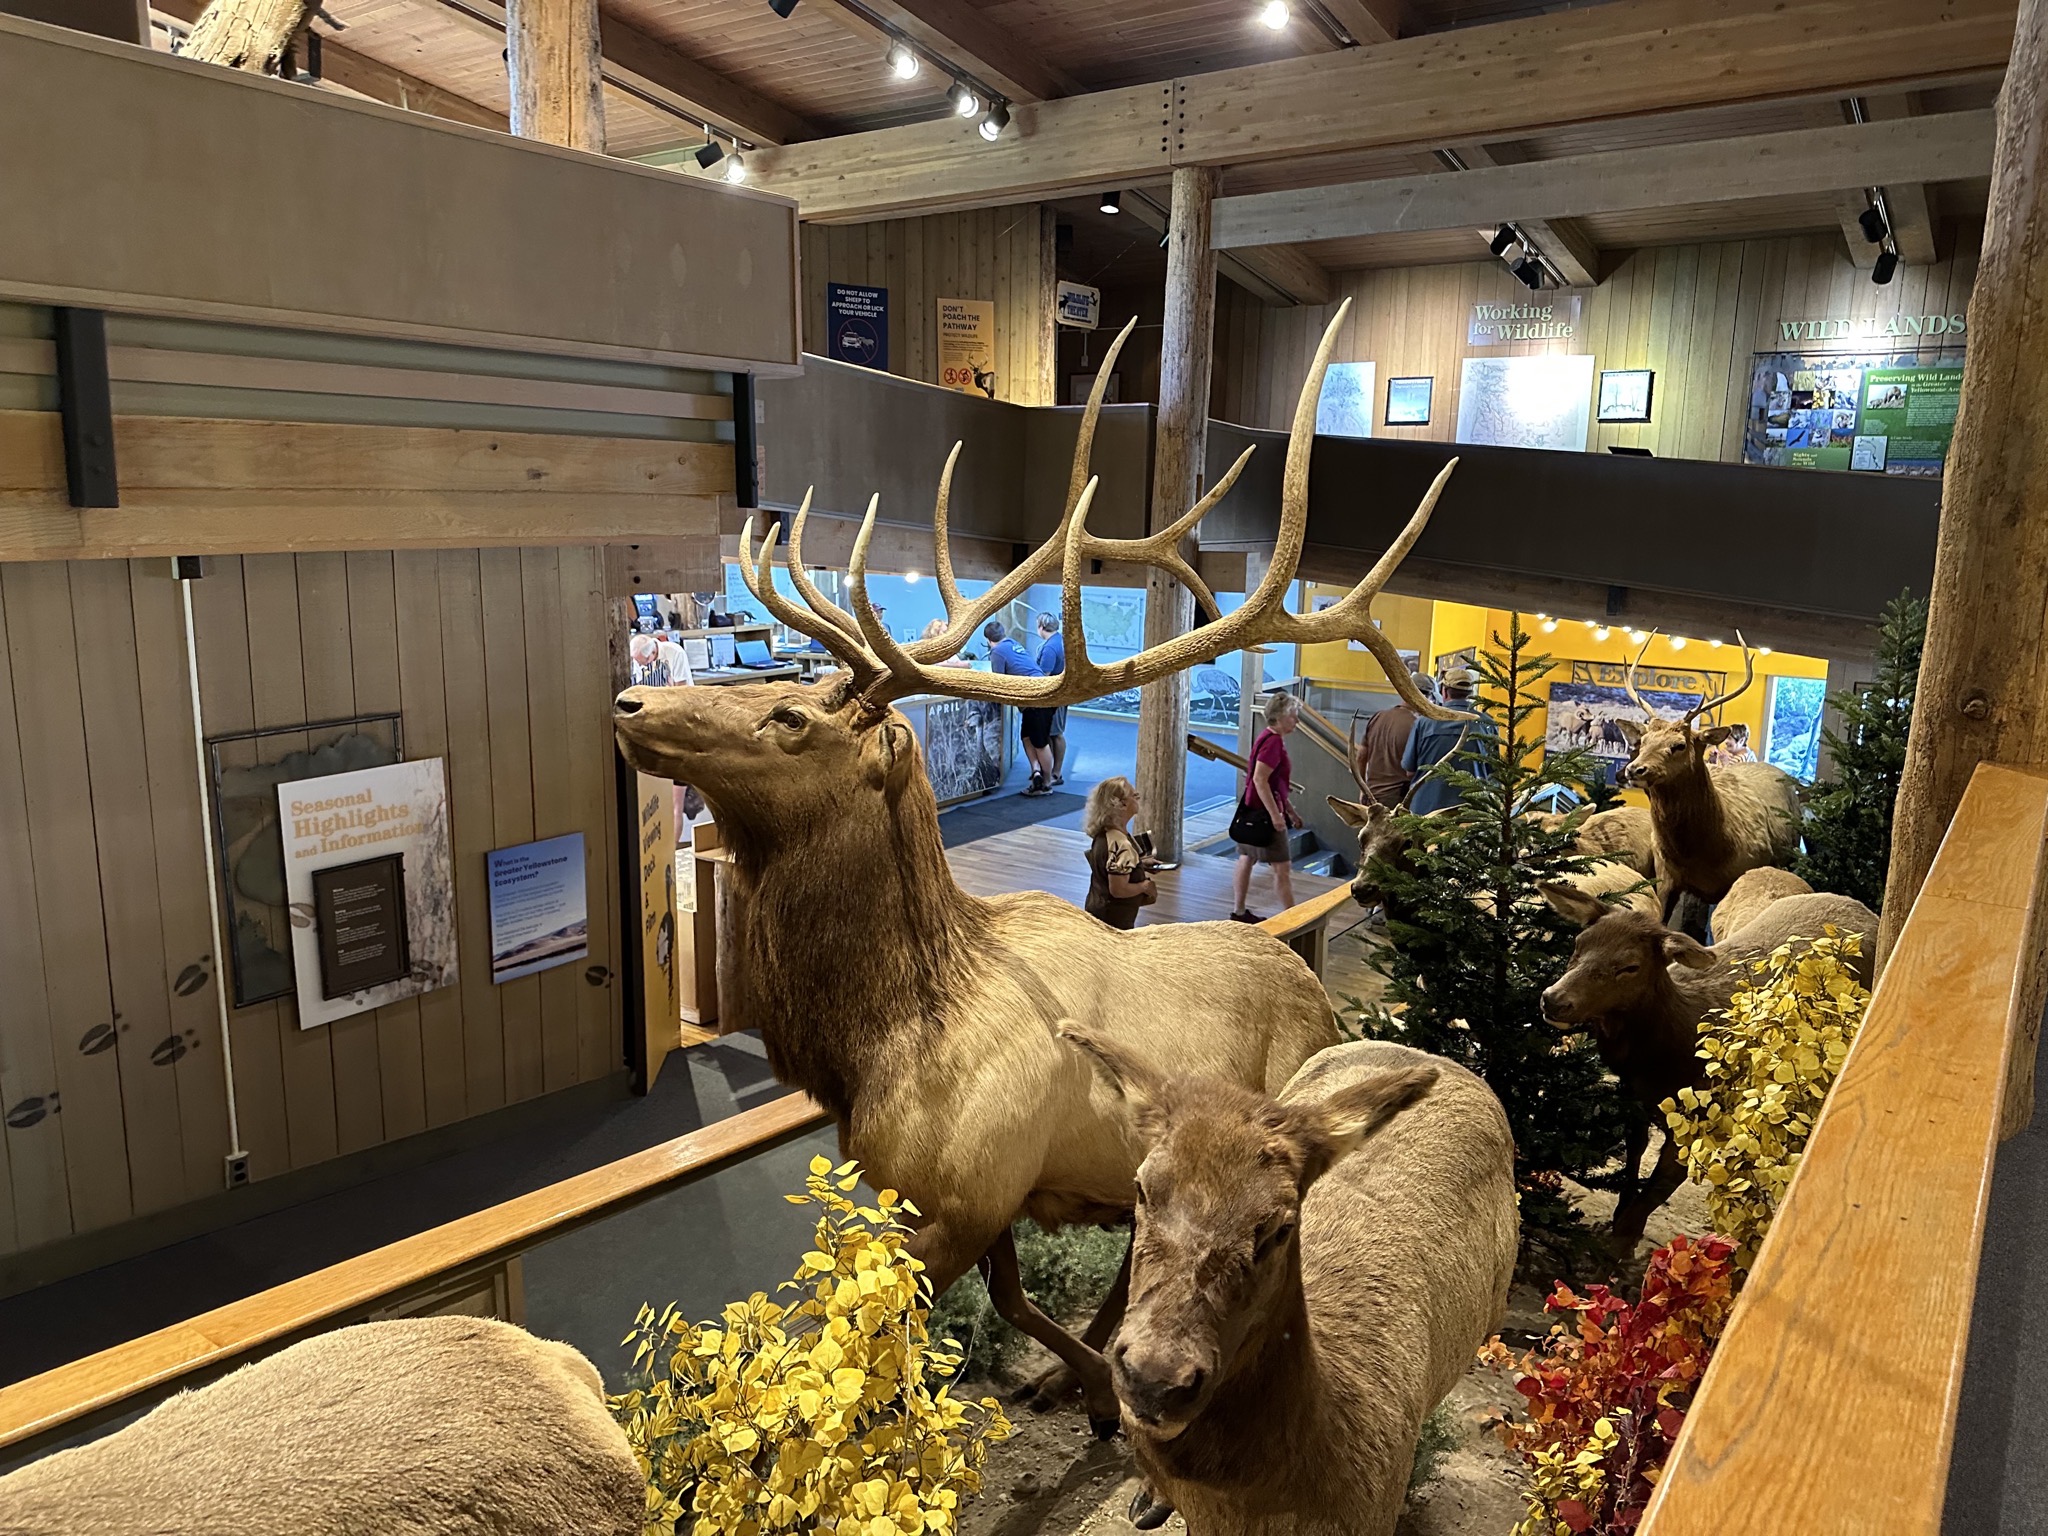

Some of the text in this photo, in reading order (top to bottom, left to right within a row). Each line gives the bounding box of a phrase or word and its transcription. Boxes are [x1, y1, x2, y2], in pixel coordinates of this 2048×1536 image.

[832, 301, 862, 310] APPROACH
[1475, 303, 1553, 321] Working
[942, 322, 977, 330] PATHWAY
[1473, 322, 1574, 340] for Wildlife
[1869, 374, 1915, 383] Preserving
[1917, 373, 1937, 381] Wild
[929, 701, 960, 716] APRIL
[291, 787, 373, 817] Seasonal
[292, 804, 409, 839] Highlights
[295, 821, 425, 859] and Information
[494, 858, 513, 868] What
[494, 856, 568, 877] Greater Yellowstone
[494, 870, 539, 887] Ecosystem?
